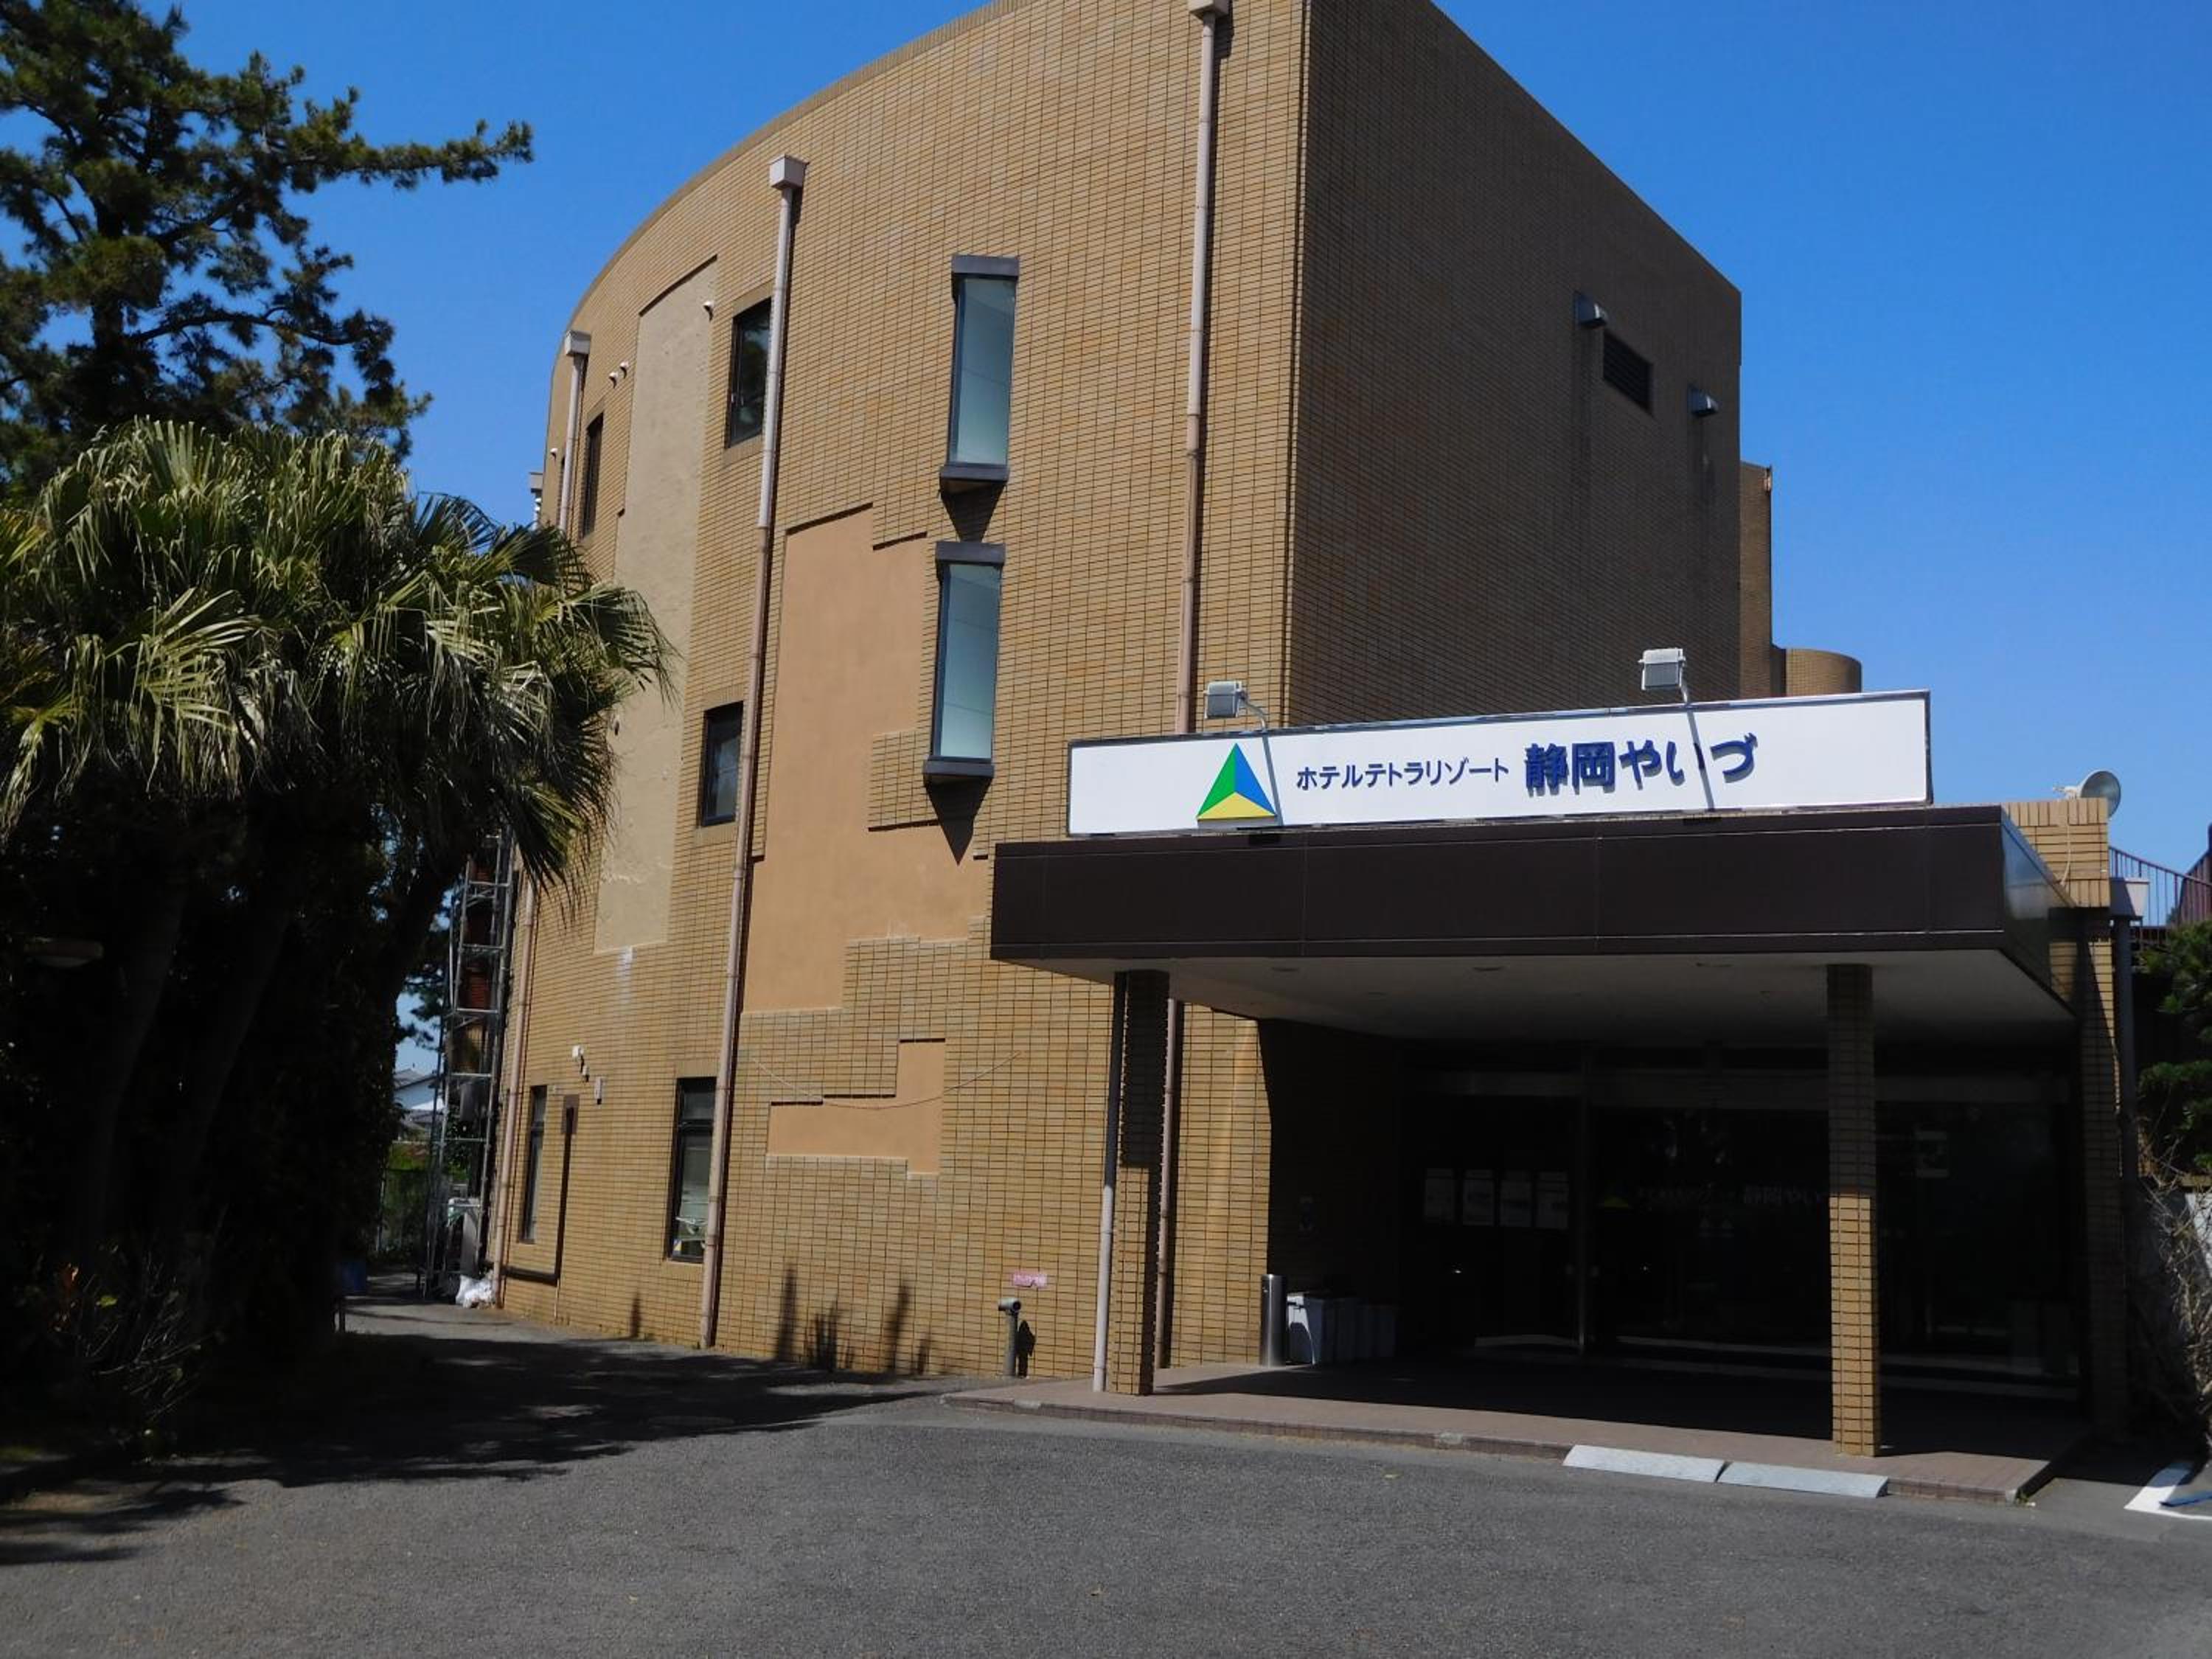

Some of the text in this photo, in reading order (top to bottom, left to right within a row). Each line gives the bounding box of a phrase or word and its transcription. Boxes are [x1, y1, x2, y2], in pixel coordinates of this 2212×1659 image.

[1295, 732, 1758, 793] ホテルテトラリゾート 静岡やいづ
